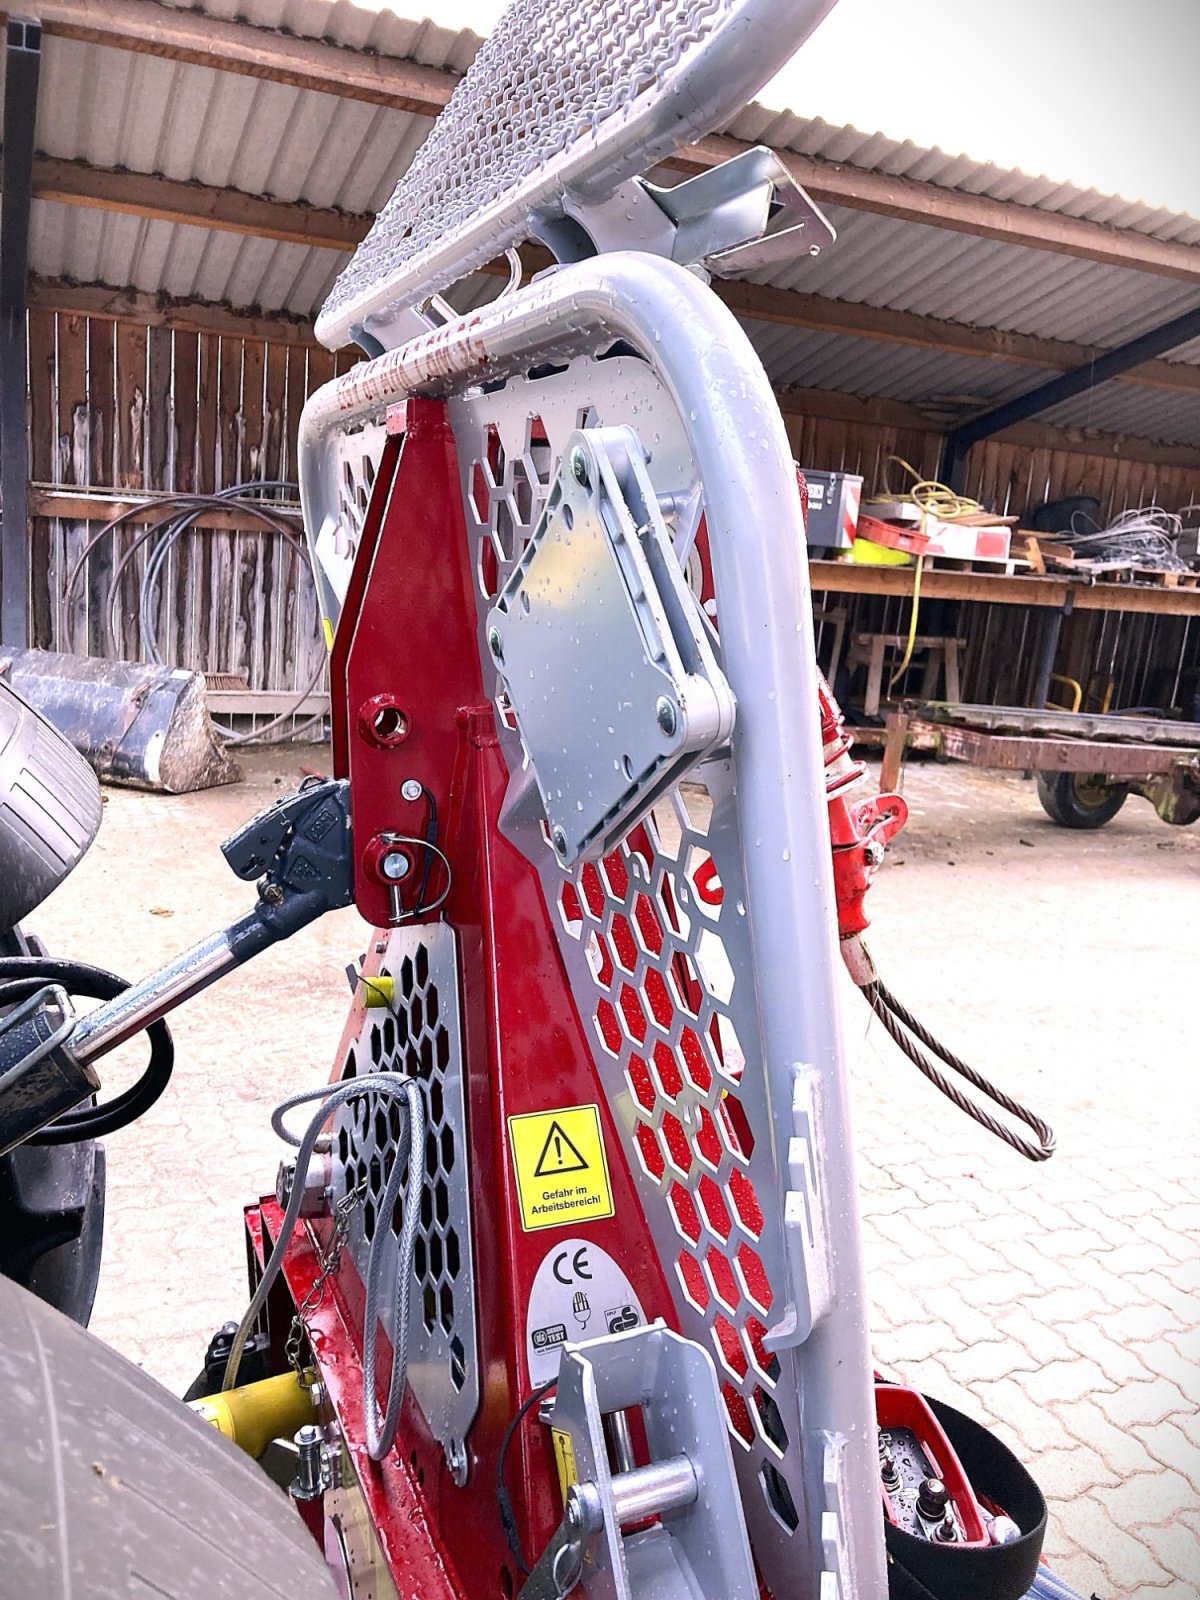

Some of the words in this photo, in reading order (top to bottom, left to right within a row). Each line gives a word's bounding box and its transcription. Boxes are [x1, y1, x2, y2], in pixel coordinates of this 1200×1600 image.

[542, 1188, 573, 1200] Gefahr
[576, 1186, 587, 1195] im
[531, 1195, 601, 1215] Arbeitsbereich!
[553, 1247, 593, 1284] CE
[609, 1306, 639, 1334] GS
[548, 1332, 565, 1343] TEST
